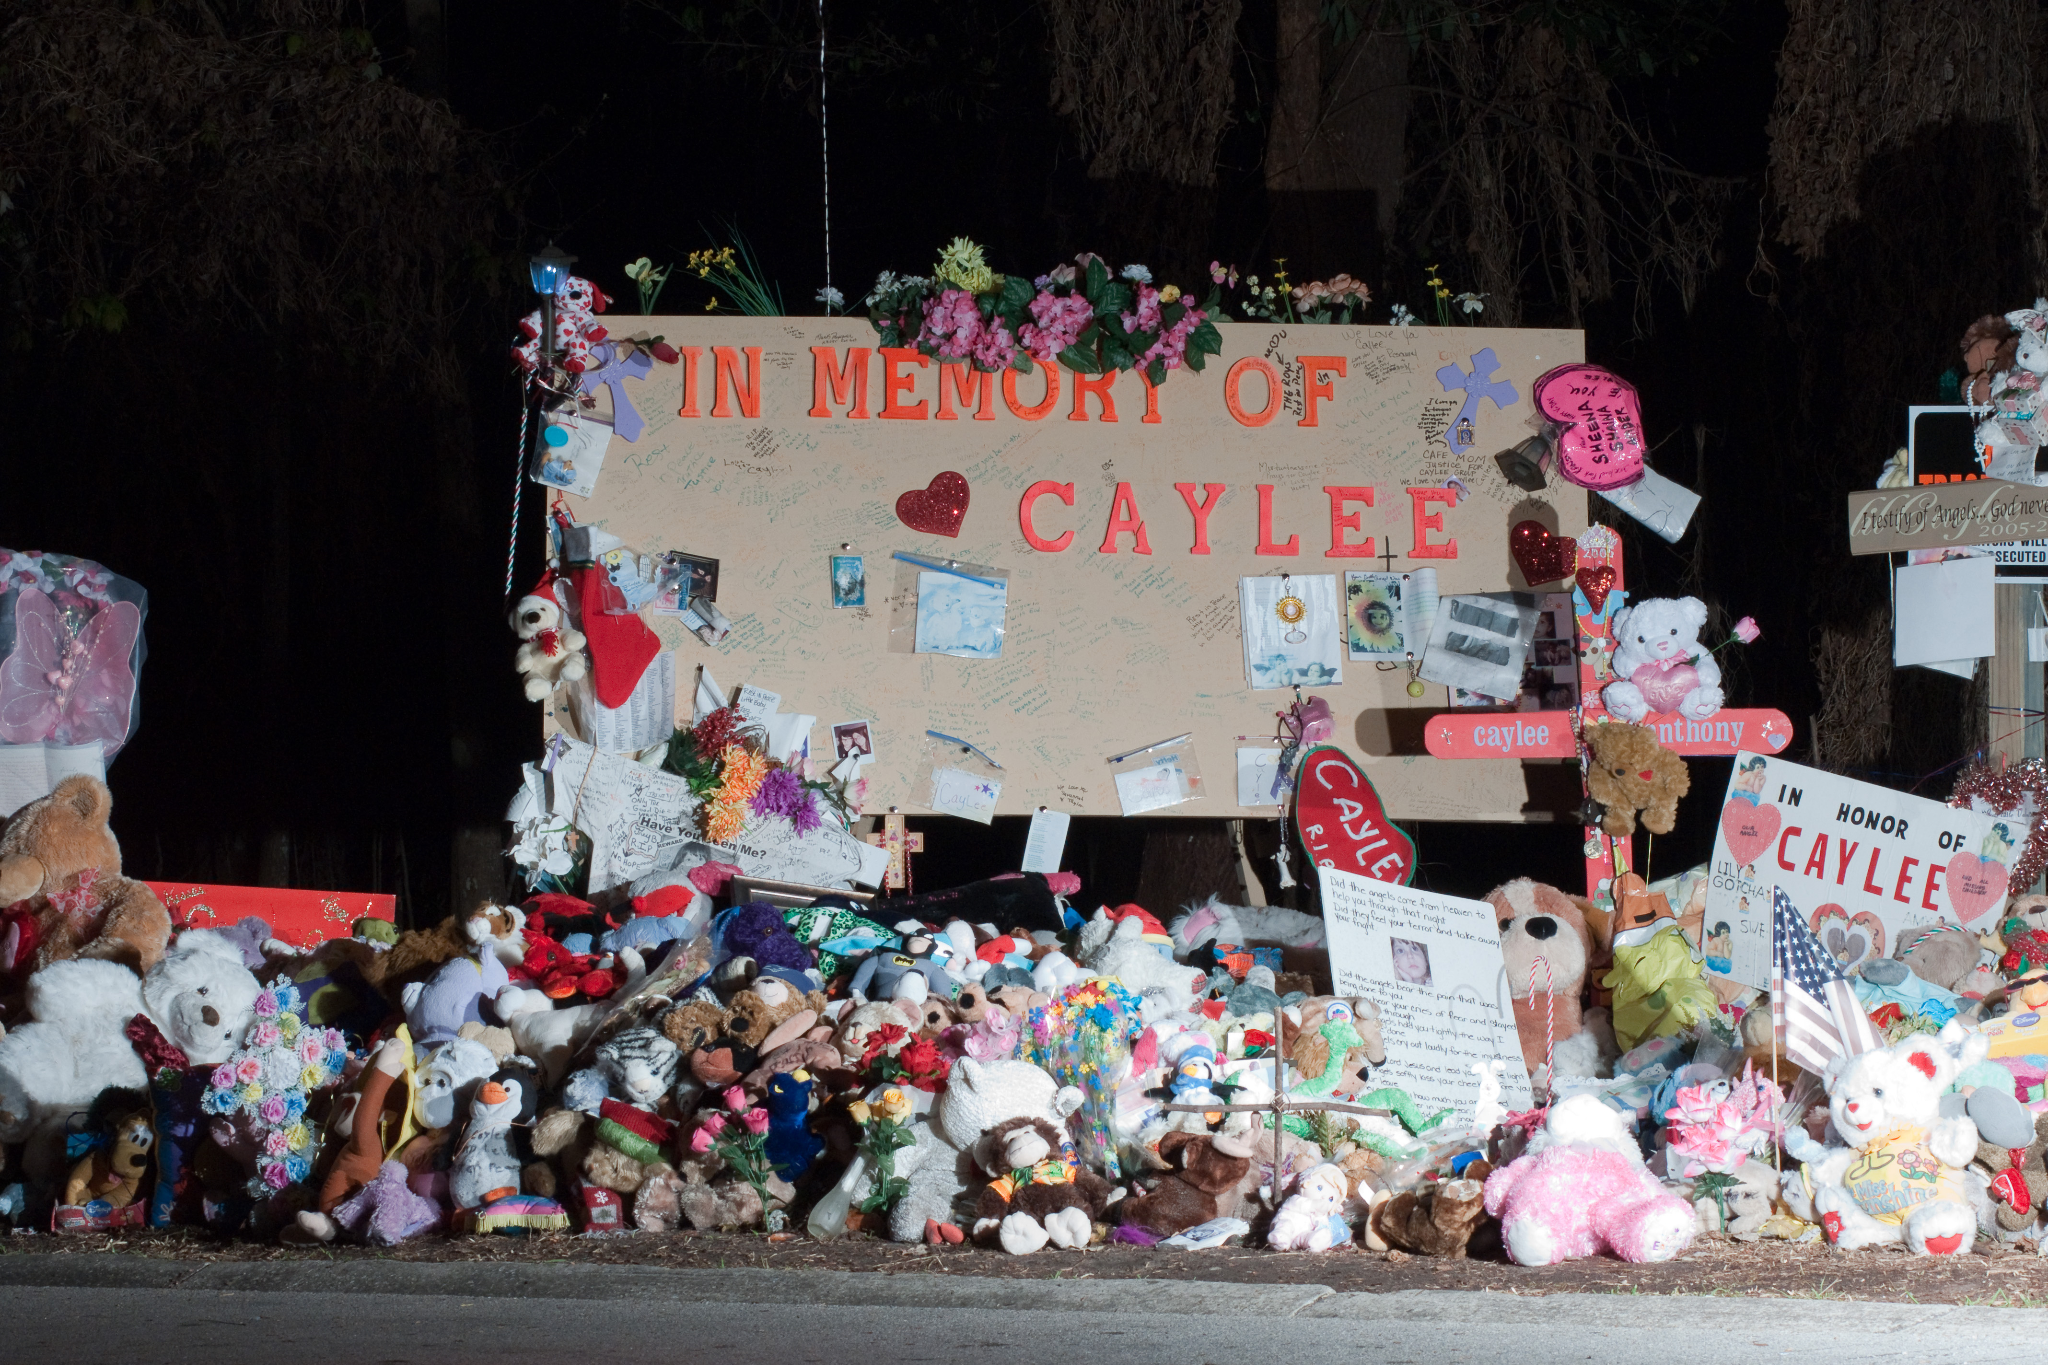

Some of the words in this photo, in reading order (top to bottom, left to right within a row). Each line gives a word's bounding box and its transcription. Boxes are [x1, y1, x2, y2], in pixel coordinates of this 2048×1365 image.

[1368, 328, 1397, 340] Love
[680, 345, 763, 418] IN
[1225, 355, 1347, 427] OF
[1419, 468, 1449, 476] CAYLEE
[1423, 449, 1448, 460] CAFE
[1456, 454, 1487, 463] MOM
[1019, 479, 1458, 560] CAYLEE
[1870, 504, 1912, 534] testify
[1915, 502, 1930, 532] of
[1990, 494, 2019, 522] God
[1473, 720, 1549, 752] caylee
[1778, 783, 1803, 807] IN
[1836, 802, 1909, 840] HONOR
[1938, 831, 1966, 853] OF
[640, 816, 673, 835] Have
[677, 826, 702, 841] You
[713, 836, 738, 851] een
[739, 844, 767, 860] Me?
[657, 837, 684, 849] REWARD
[1716, 860, 1743, 879] LILY
[1777, 825, 1947, 912] CAYLEE
[1329, 875, 1346, 888] Did
[1350, 881, 1367, 895] the
[1368, 888, 1396, 903] angels
[1419, 897, 1440, 912] from
[1442, 901, 1474, 918] heaven
[1475, 909, 1486, 920] to
[1331, 888, 1351, 904] help
[1351, 897, 1367, 910] you
[1368, 899, 1399, 915] through
[1400, 904, 1421, 919] that
[1423, 913, 1447, 926] night
[1333, 902, 1349, 915] Did
[1349, 906, 1370, 924] they
[1370, 911, 1387, 925] feel
[1408, 919, 1433, 934] terror
[1456, 928, 1476, 942] take
[1477, 936, 1501, 949] away
[1338, 967, 1353, 979] Did
[1354, 972, 1369, 985] the
[1369, 977, 1394, 992] angels
[1417, 986, 1434, 999] the
[1378, 986, 1388, 997] to
[1388, 990, 1404, 1002] you
[2015, 1016, 2039, 1025] Disney
[1497, 1035, 1505, 1044] I
[1855, 1179, 1887, 1200] Miss
[1860, 1180, 1938, 1216] unshine
